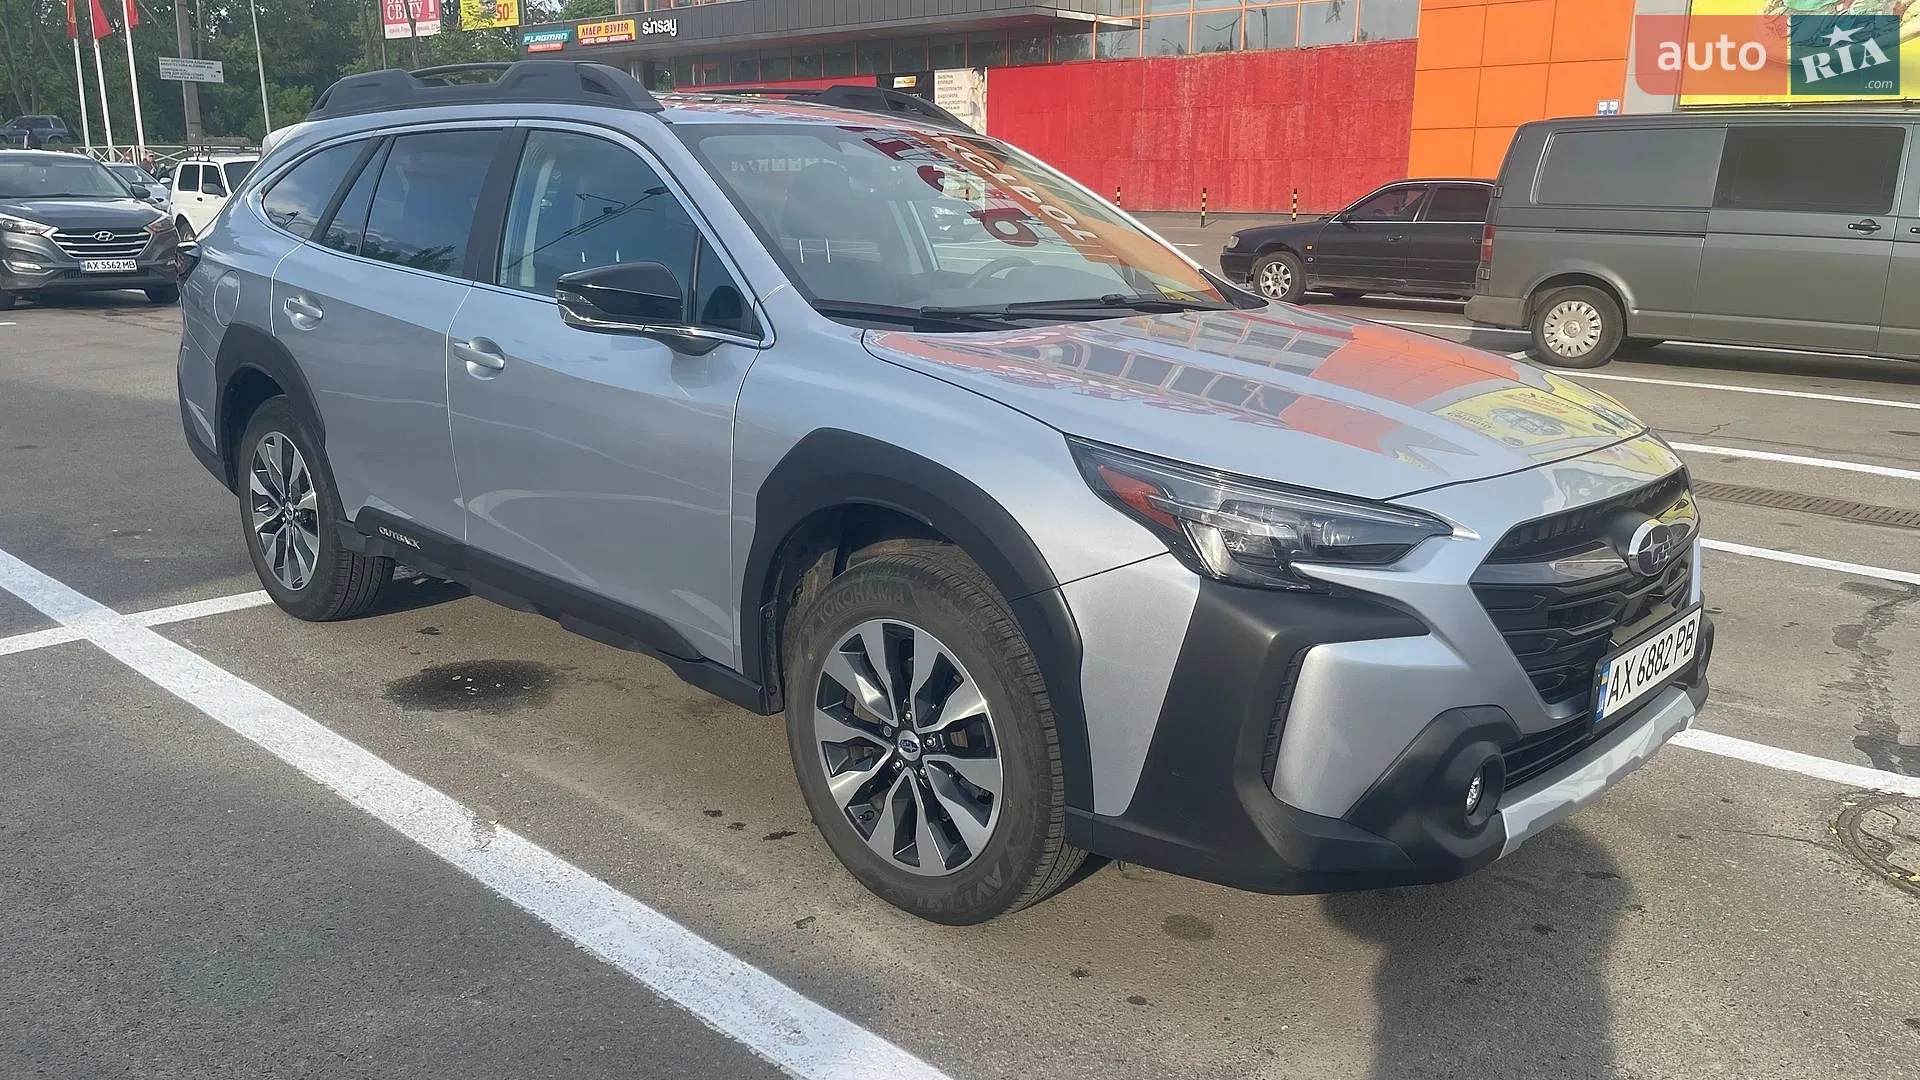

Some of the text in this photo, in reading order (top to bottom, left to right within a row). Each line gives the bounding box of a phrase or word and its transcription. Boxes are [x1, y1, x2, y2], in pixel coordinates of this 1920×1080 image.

[642, 17, 677, 37] sinsay
[101, 261, 121, 270] 5562
[122, 260, 136, 269] MB
[379, 526, 421, 550] OUTBACK
[1606, 618, 1696, 708] AX 6882 PB
